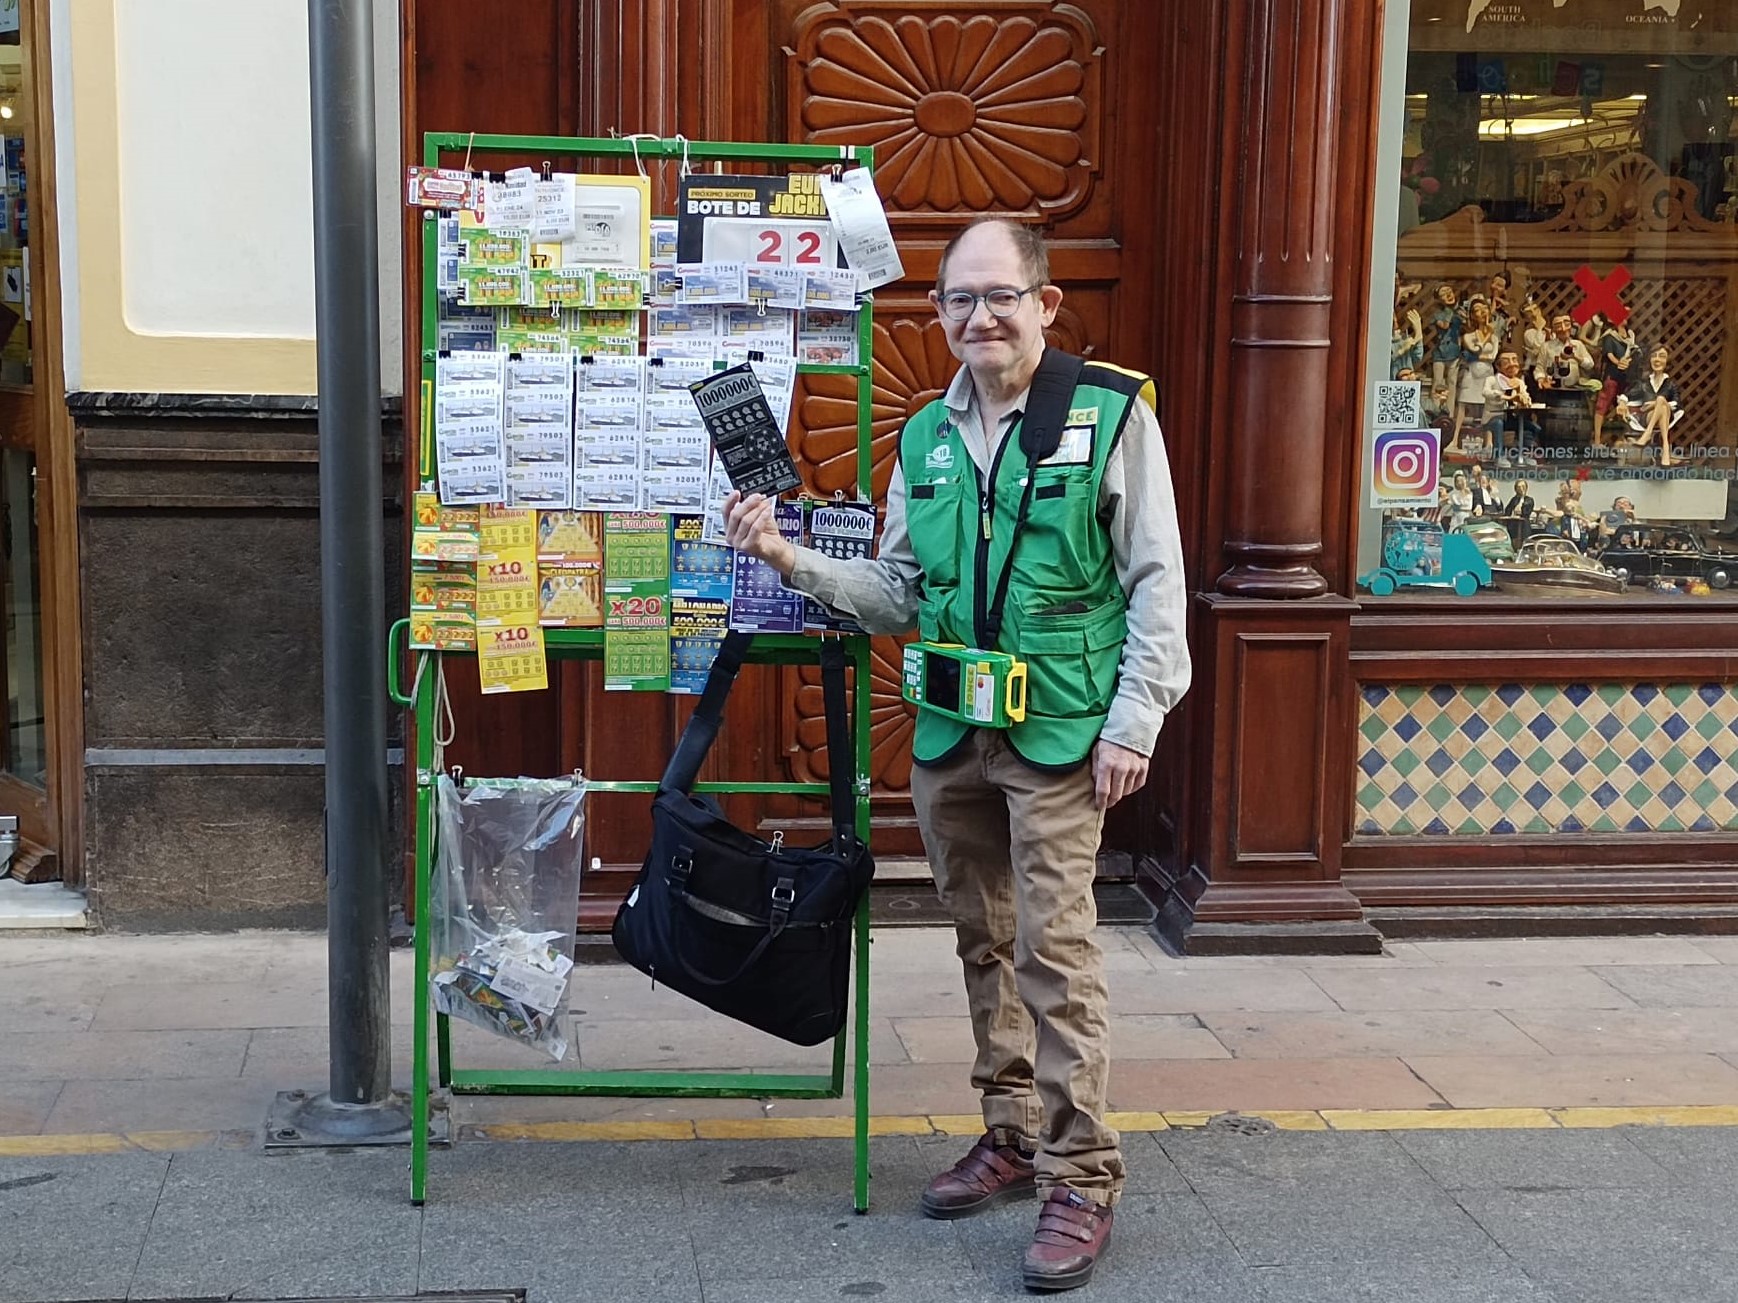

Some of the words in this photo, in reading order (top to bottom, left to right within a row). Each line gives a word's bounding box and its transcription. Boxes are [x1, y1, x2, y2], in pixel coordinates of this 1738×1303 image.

[1489, 5, 1521, 14] SOUTH
[1481, 14, 1526, 23] AMERICA
[1625, 15, 1668, 24] OCEANIA
[725, 191, 753, 199] SORTEO
[687, 200, 735, 215] BOTE
[737, 201, 761, 216] DE
[1554, 466, 1570, 481] la
[1596, 469, 1616, 481] ve
[1621, 466, 1699, 481] andando
[488, 561, 522, 576] x10
[609, 597, 662, 617] x20
[673, 616, 727, 628] 500.000€
[495, 627, 529, 642] x10
